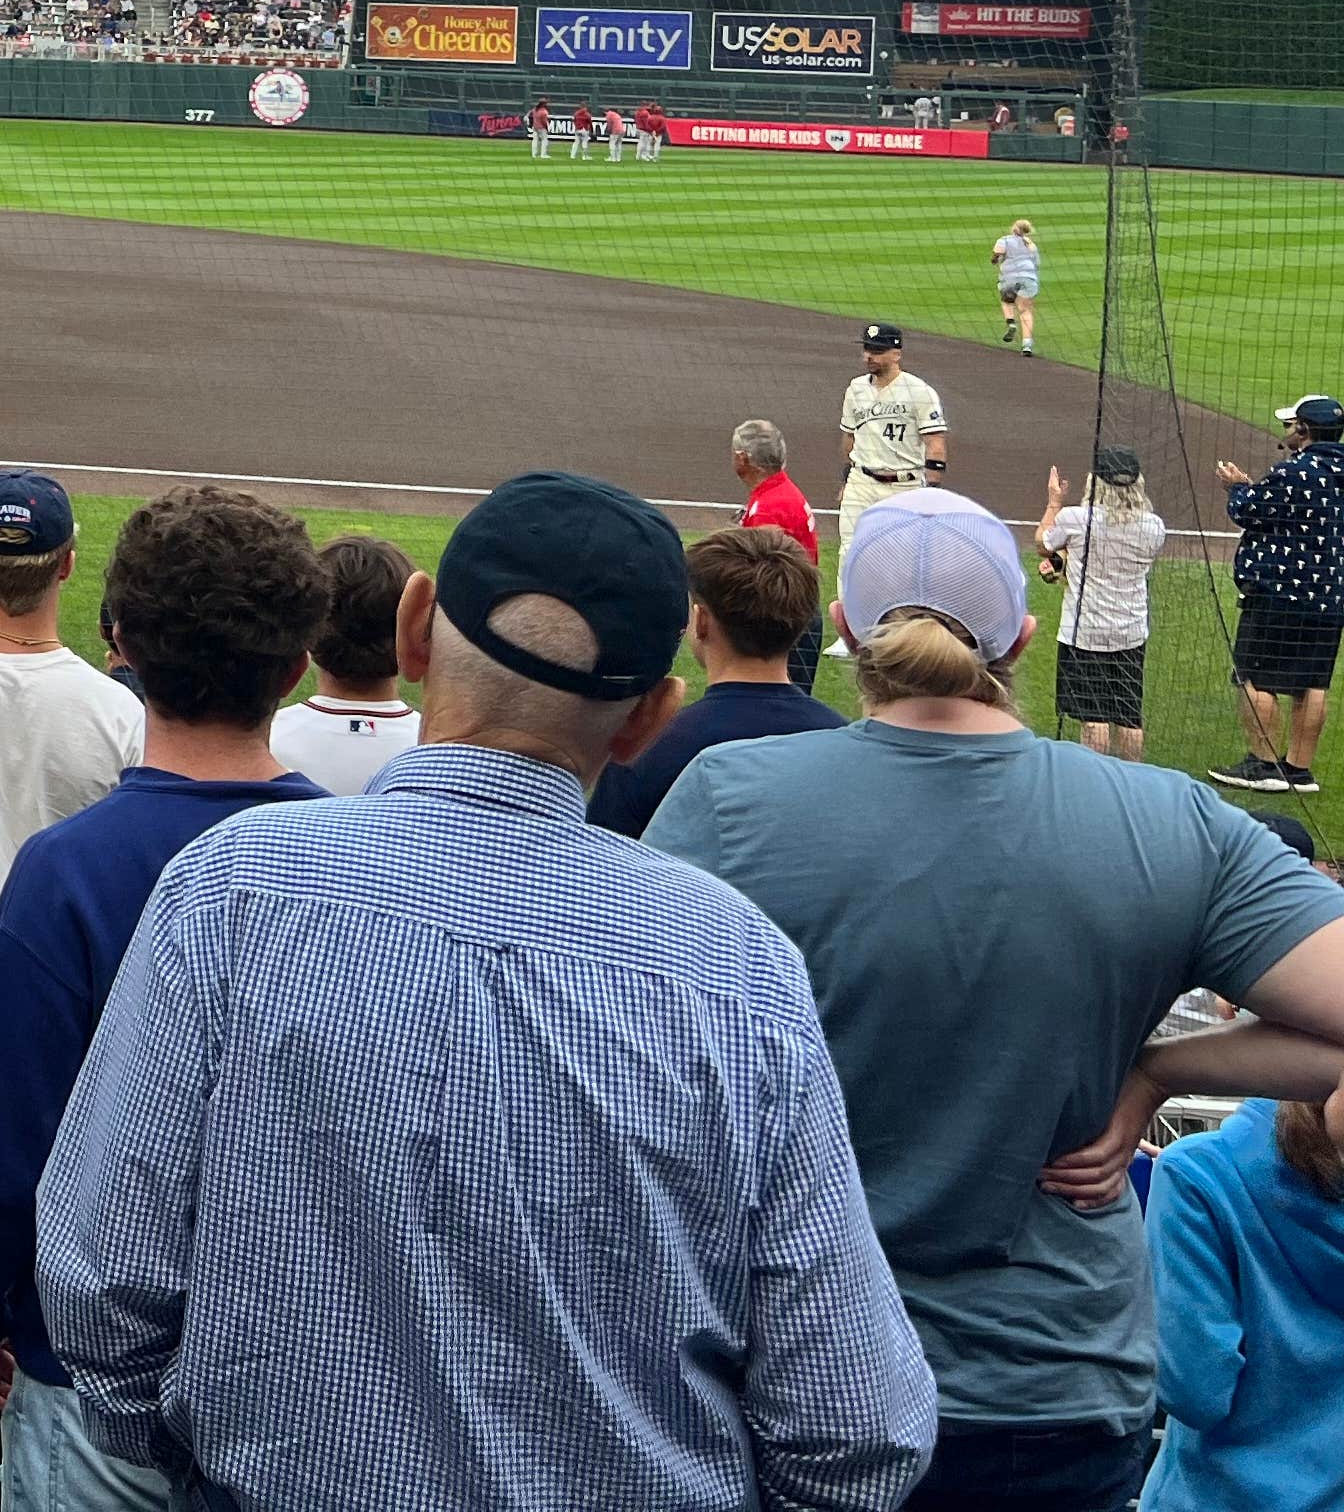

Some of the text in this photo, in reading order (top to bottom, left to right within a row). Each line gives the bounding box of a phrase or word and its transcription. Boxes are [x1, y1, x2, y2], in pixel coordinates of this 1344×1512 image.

[444, 15, 508, 33] Honey Nut
[977, 7, 1081, 23] HIT THE BUDS
[414, 24, 511, 54] Cheerios
[544, 16, 683, 62] xfinity
[761, 54, 862, 68] us-solar.com
[185, 109, 215, 122] 377
[691, 125, 746, 144] GETTING
[749, 128, 787, 145] MORE
[789, 130, 821, 146] KIDS
[856, 133, 882, 148] THE
[884, 134, 923, 150] GAME
[883, 422, 906, 441] 47
